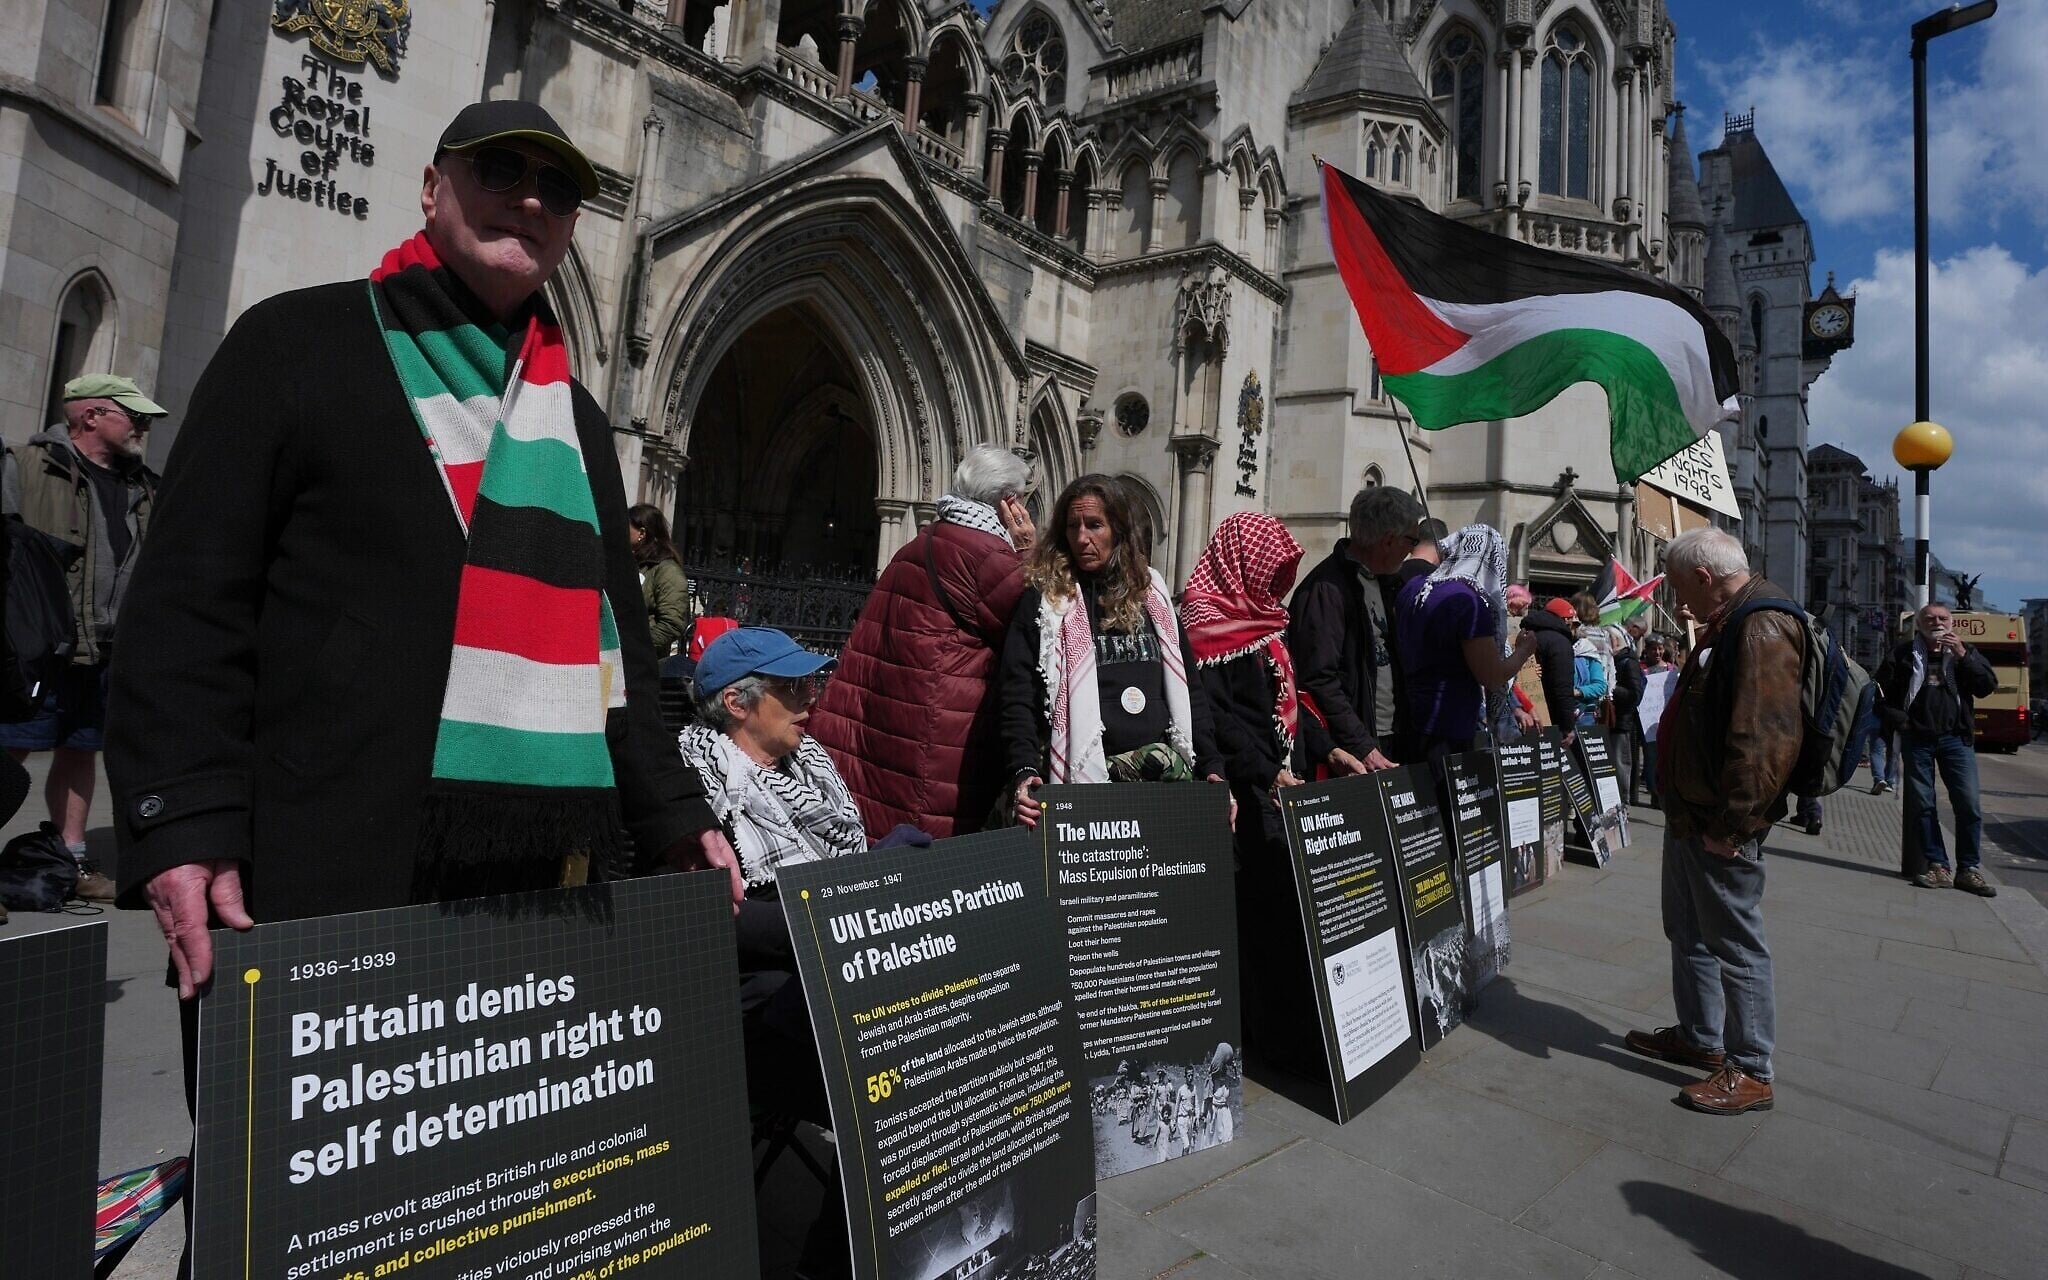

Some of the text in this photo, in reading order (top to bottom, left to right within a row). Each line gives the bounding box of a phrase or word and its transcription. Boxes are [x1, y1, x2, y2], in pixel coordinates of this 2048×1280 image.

[282, 75, 370, 137] Royal
[302, 54, 363, 103] The
[269, 103, 375, 167] Courts
[300, 150, 339, 179] of
[258, 157, 369, 220] Justice
[1674, 472, 1712, 501] 1998
[1055, 802, 1073, 810] 1948
[1055, 819, 1141, 842] The NAKBA
[1300, 812, 1344, 832] UN Affirms
[1058, 860, 1206, 884] Mass Expulsion of Palestinians
[1304, 830, 1362, 855] Right of Return
[820, 872, 902, 898] 29 November 1947
[828, 879, 1024, 944] UN Endorses Partition
[1059, 890, 1159, 906] Israeli military and paramilitaries:
[841, 932, 957, 983] of Palestine
[1068, 936, 1122, 949] Loot their homes
[1068, 949, 1119, 962] Poison the wells
[291, 972, 575, 1057] Britain denies
[852, 962, 1021, 1025] The UN votes to divide Palestine into separate
[857, 981, 1010, 1042] Jewish and Arab states, despite opposition
[291, 1004, 662, 1121] Palestinian right to
[860, 1011, 972, 1059] from the Palestinian majority.
[900, 1000, 1063, 1073] of the land allocated to the Jewish state, although
[903, 1018, 1058, 1090] Palestinian Arabs made up twice the population.
[866, 1066, 902, 1103] 56%
[873, 1044, 1054, 1133] Zionists accepted the partition publicly but sought to
[288, 1058, 654, 1184] self determination
[287, 1123, 647, 1253] A mass revolt against British rule and colonial
[287, 1231, 395, 1280] settlement
[399, 1226, 414, 1243] is
[418, 1199, 486, 1236] crushed
[489, 1179, 549, 1212] through
[552, 1154, 634, 1190] executions,
[636, 1140, 670, 1161] mass
[885, 1159, 950, 1202] expelled or fled.
[374, 1250, 409, 1278] and
[413, 1223, 499, 1263] collective
[502, 1187, 596, 1234] punishment.
[495, 1238, 561, 1274] viciously
[564, 1208, 631, 1248] repressed
[633, 1202, 655, 1219] the
[525, 1262, 552, 1280] and
[556, 1241, 612, 1274] uprising
[613, 1227, 647, 1250] when
[649, 1218, 671, 1234] the
[599, 1259, 615, 1279] of
[616, 1253, 640, 1271] the
[642, 1222, 711, 1263] population.
